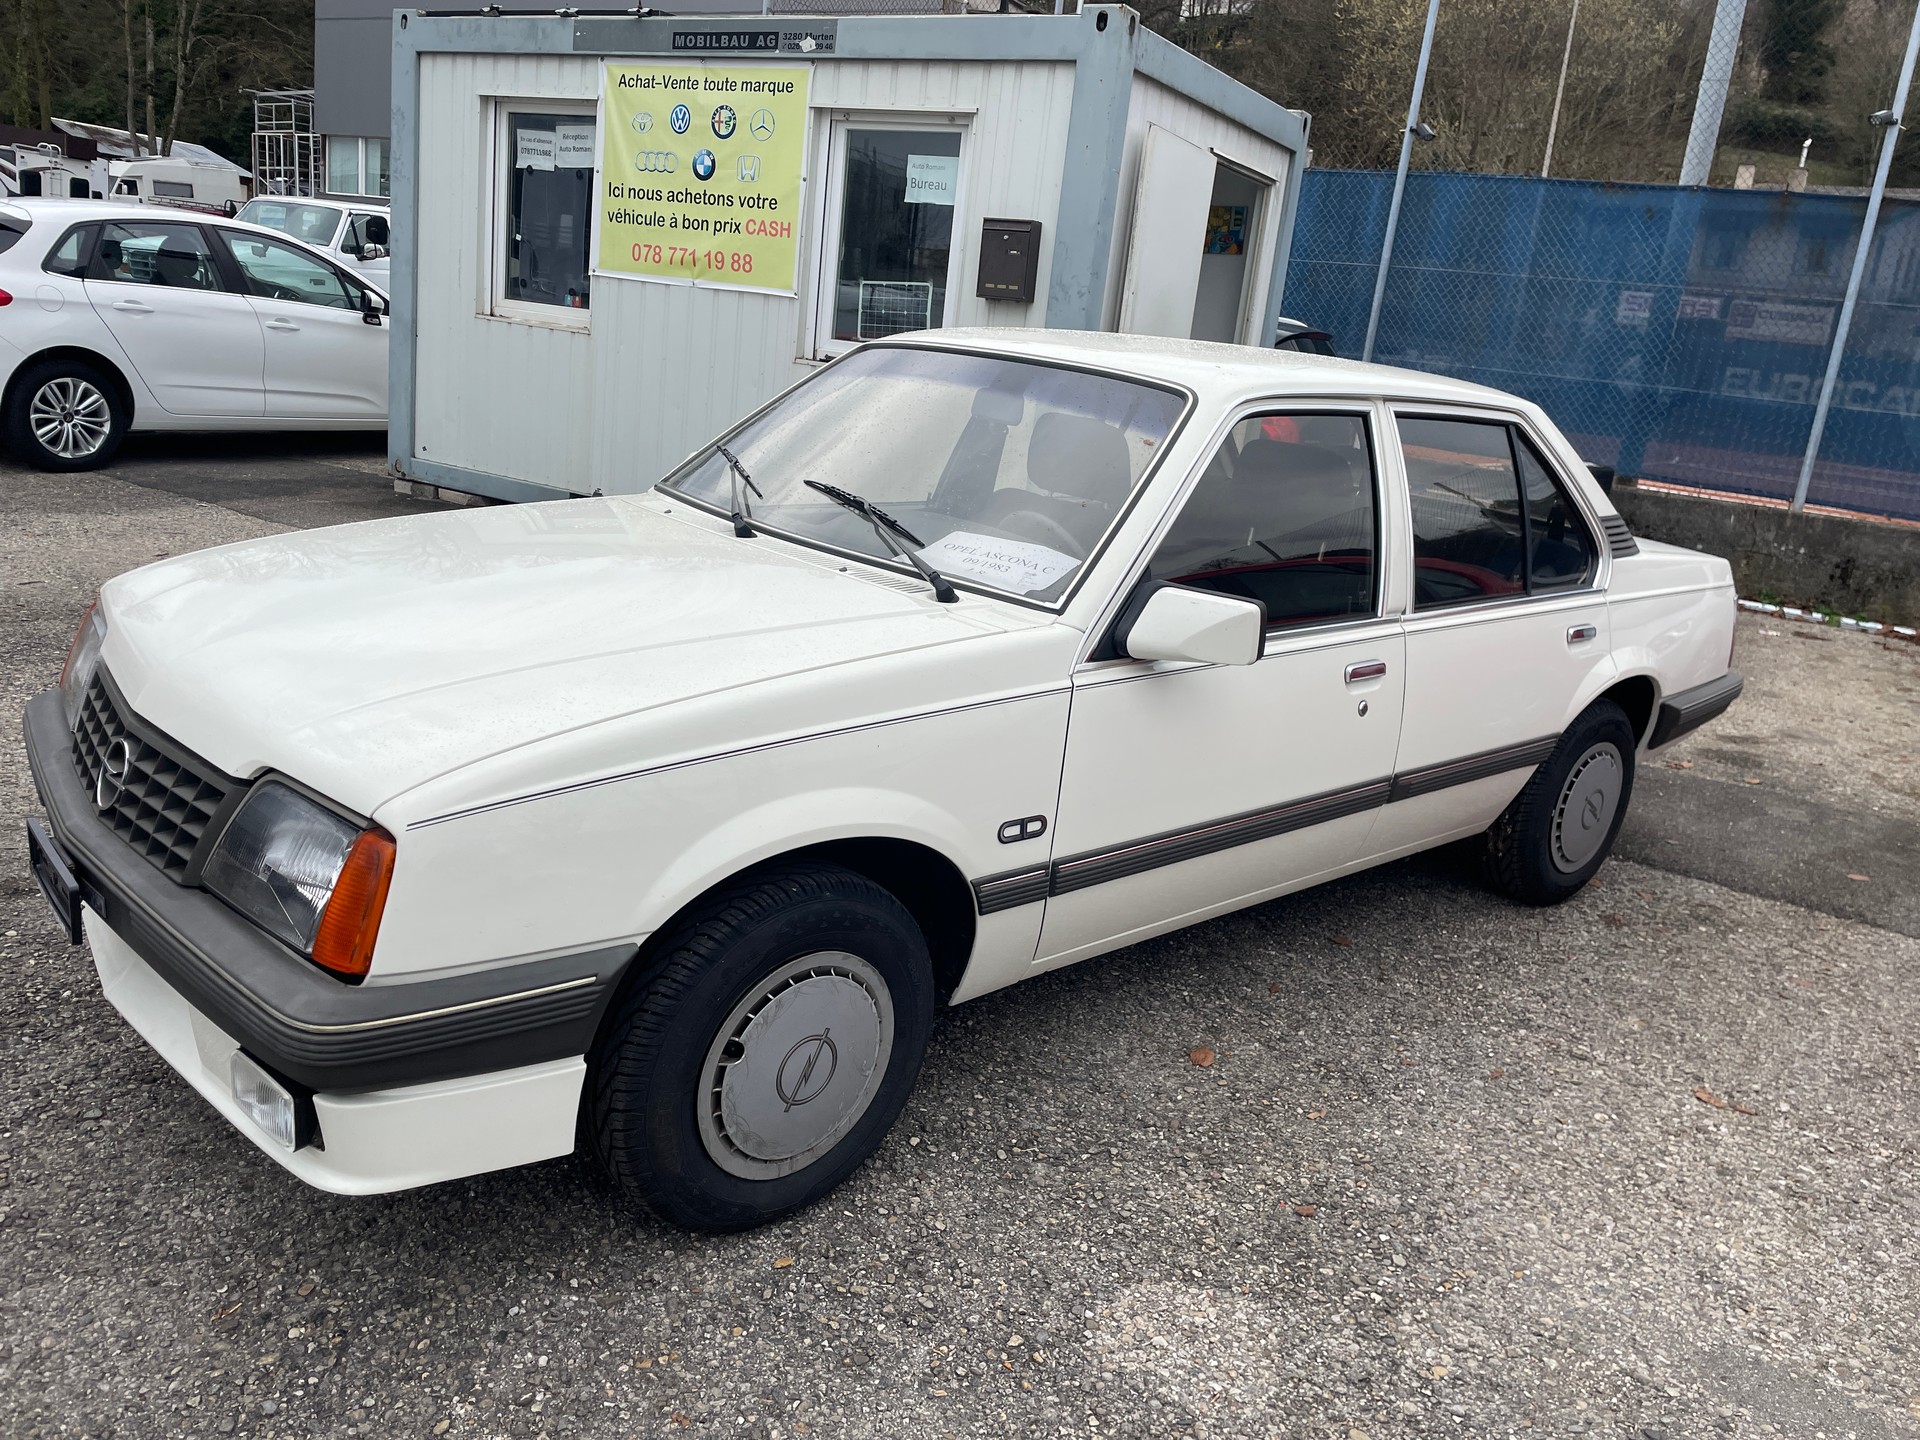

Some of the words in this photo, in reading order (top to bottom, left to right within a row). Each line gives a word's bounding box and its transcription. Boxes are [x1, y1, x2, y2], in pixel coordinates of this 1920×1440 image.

[674, 35, 749, 48] MOBILBAU
[756, 35, 776, 48] AG
[782, 32, 803, 41] 3280
[703, 77, 738, 92] toute
[740, 80, 795, 96] marque
[562, 132, 589, 142] Réception
[559, 145, 572, 153] Auto
[573, 145, 593, 153] Romani
[910, 177, 947, 190] Bureau
[608, 182, 624, 198] Ici
[628, 187, 663, 202] nous
[666, 187, 734, 207] achetons
[738, 193, 778, 210] votre
[607, 208, 665, 228] véhicule
[669, 213, 678, 229] à
[682, 214, 709, 231] bon
[713, 218, 742, 236] prix
[745, 218, 792, 238] CASH
[631, 243, 662, 264] 078
[668, 246, 697, 268] 771
[704, 250, 725, 271] 19
[730, 252, 753, 273] 88
[944, 543, 977, 555] OPEL
[979, 551, 1039, 570] ASCONA
[1042, 566, 1056, 574] C
